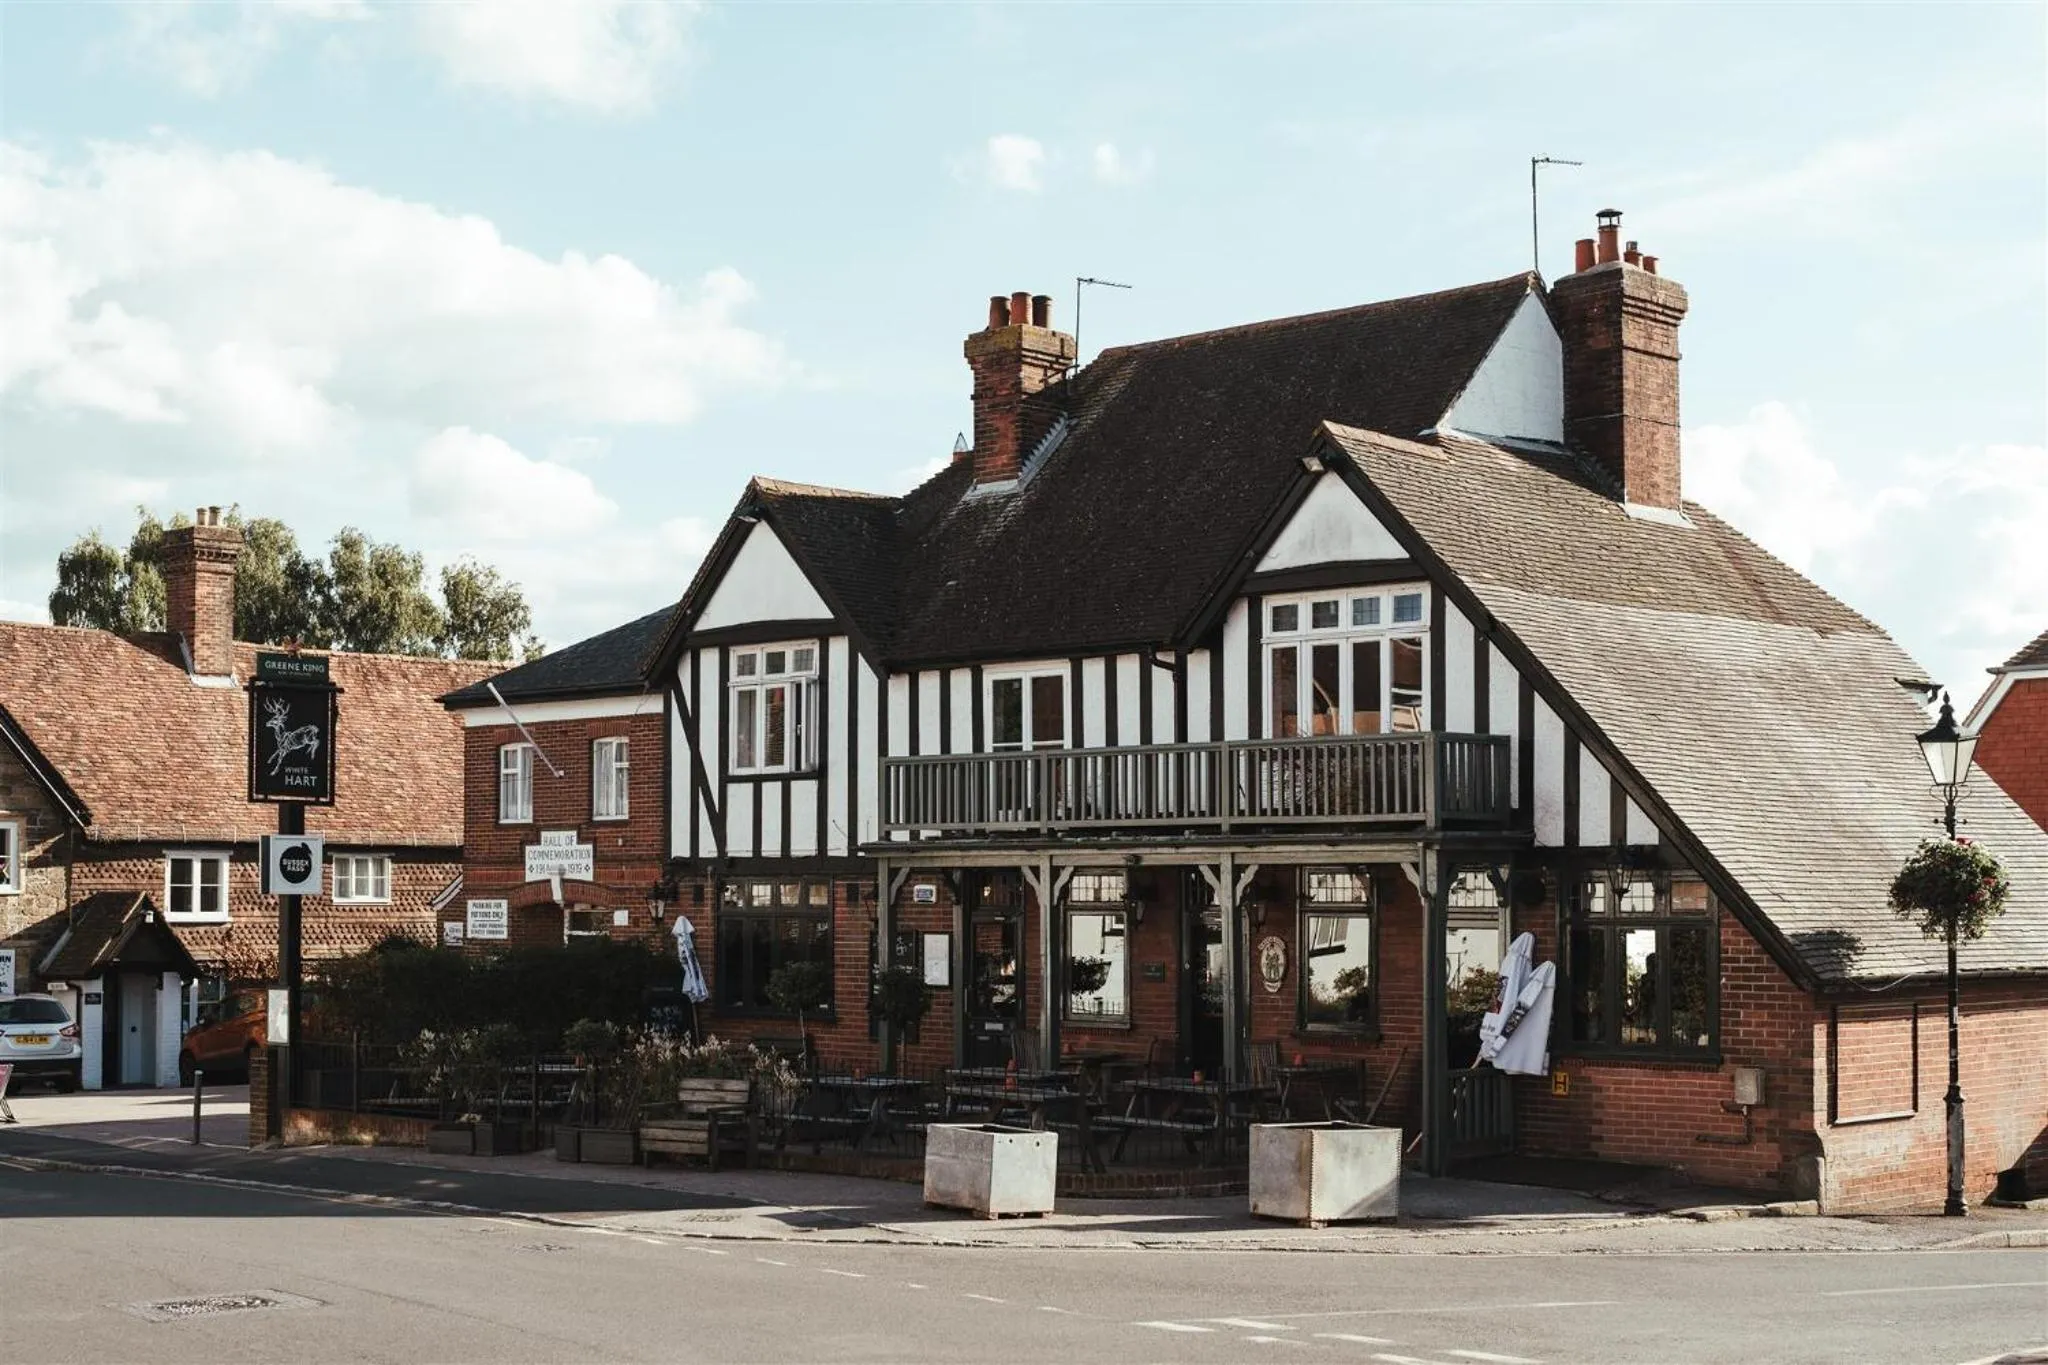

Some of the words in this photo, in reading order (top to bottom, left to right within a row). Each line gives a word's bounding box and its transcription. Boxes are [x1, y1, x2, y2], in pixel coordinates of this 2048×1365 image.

[264, 660, 300, 671] GREENE
[303, 664, 325, 673] KING
[284, 775, 317, 786] HART
[543, 836, 562, 846] HALL
[565, 836, 575, 846] OF
[528, 848, 591, 860] COMMEMORATION
